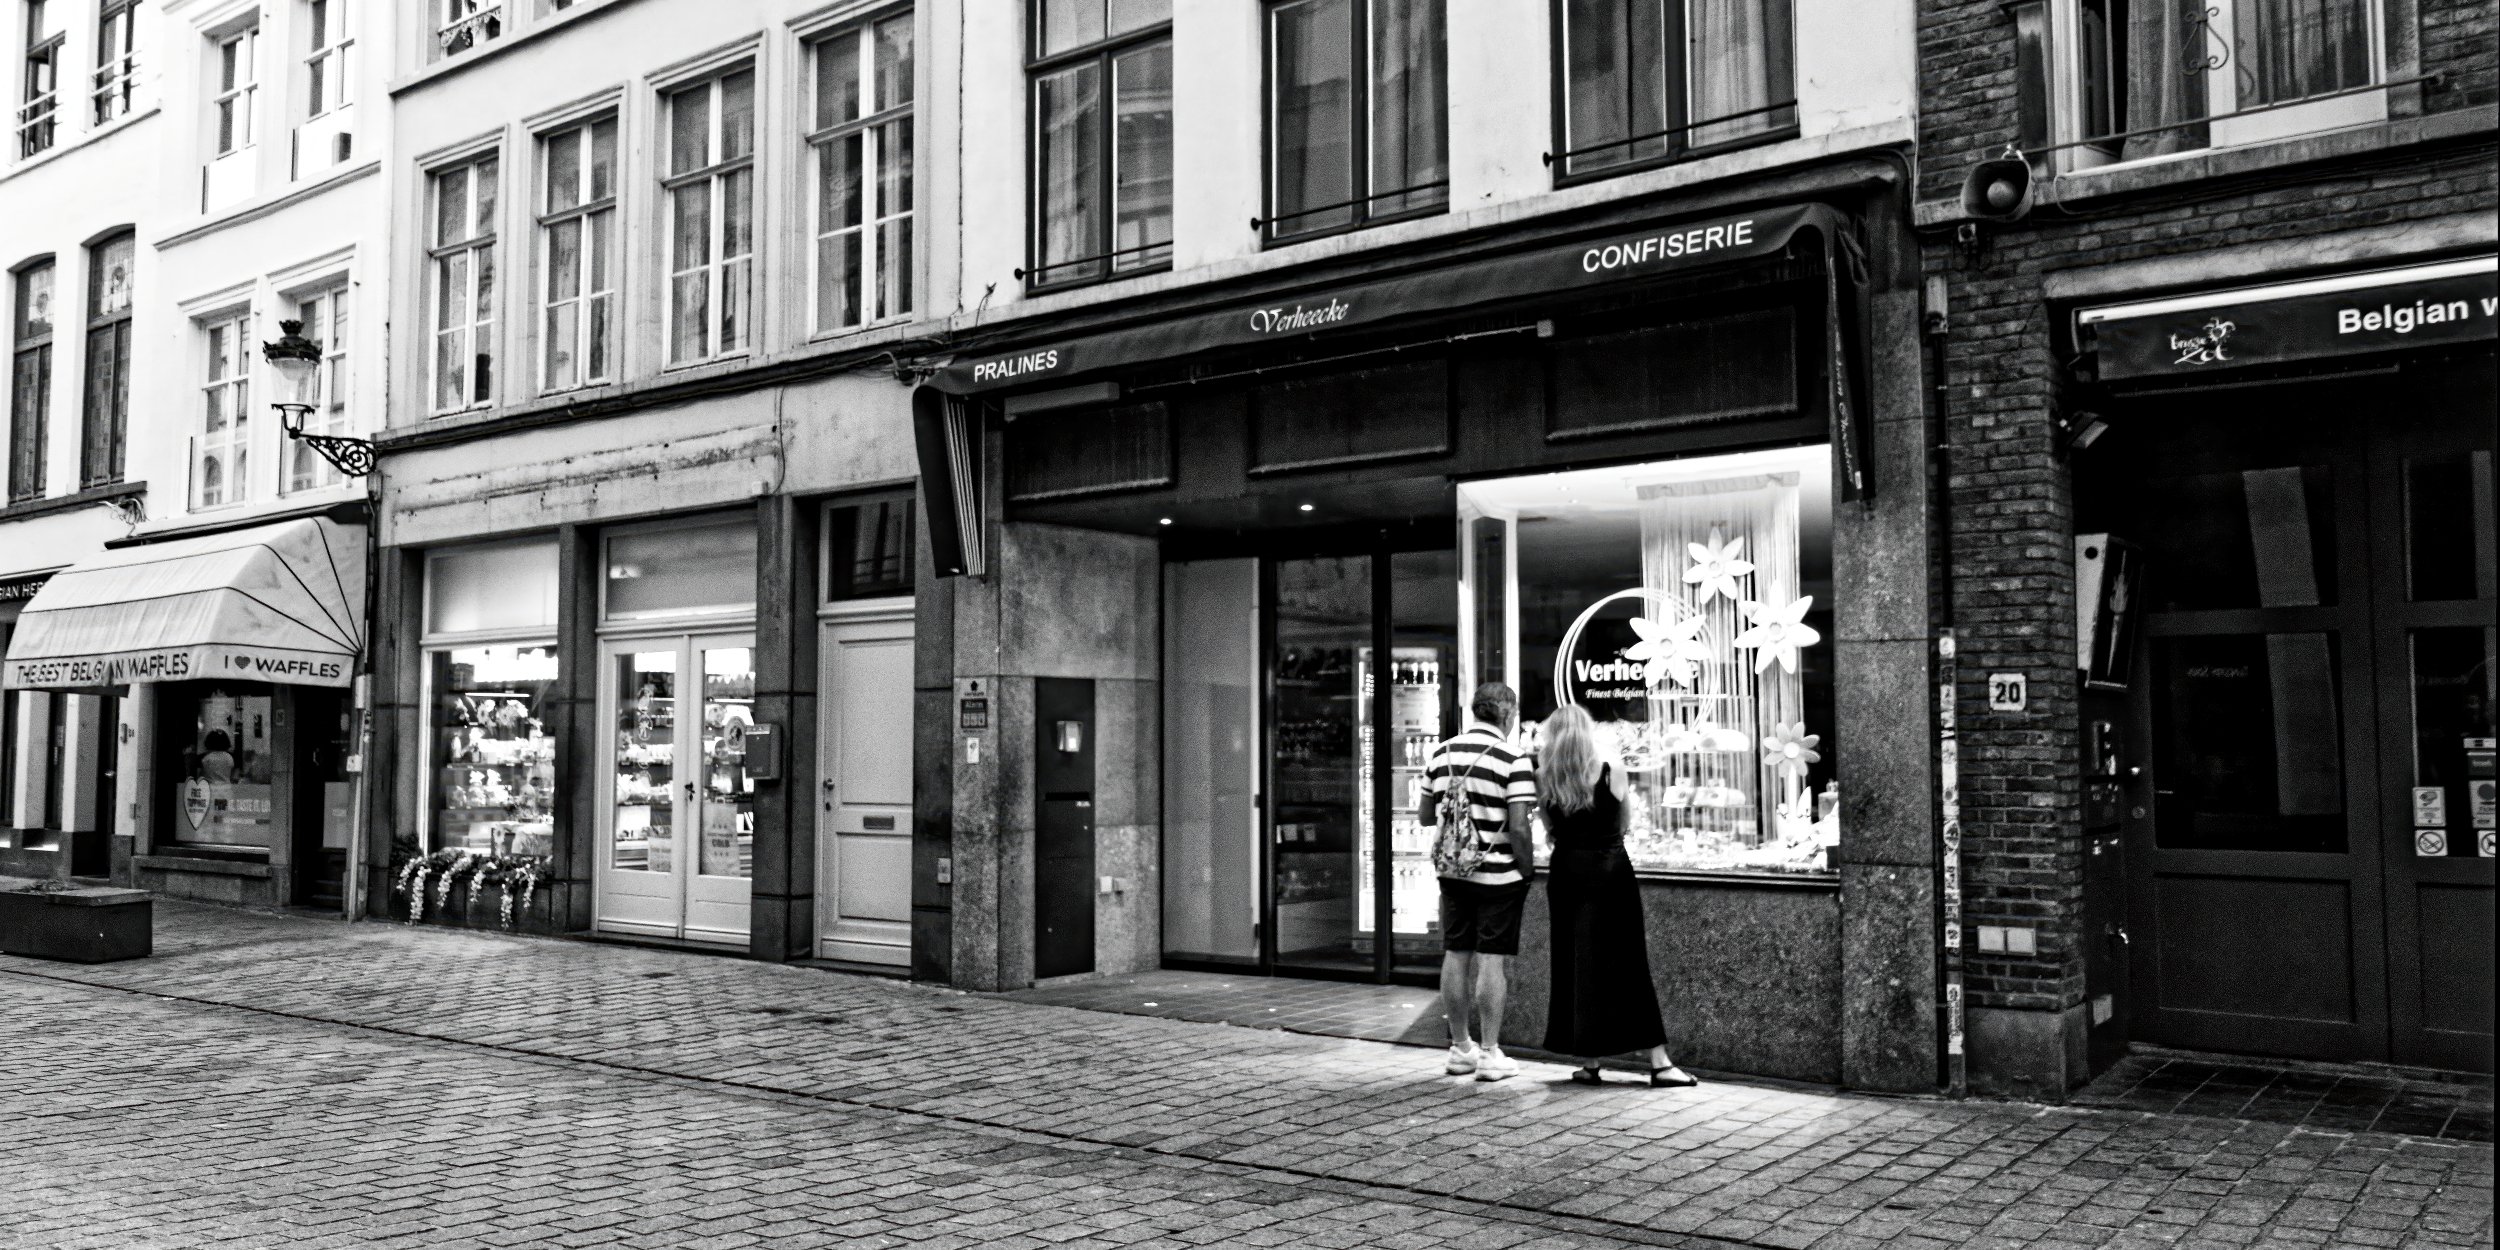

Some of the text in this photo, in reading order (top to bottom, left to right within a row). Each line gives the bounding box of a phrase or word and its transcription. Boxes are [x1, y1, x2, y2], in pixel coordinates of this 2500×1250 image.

[1583, 220, 1753, 272] CONFISERIE
[1250, 298, 1349, 333] Verheecke
[2338, 299, 2469, 334] Belgian
[974, 349, 1058, 383] PRALINES
[17, 664, 37, 684] THE
[37, 663, 69, 683] BEST
[127, 653, 189, 678] WAFFLES
[224, 655, 340, 678] I WAFFLES
[1575, 658, 1698, 682] Verhee
[1613, 687, 1644, 701] Belgian
[1995, 681, 2020, 703] 20
